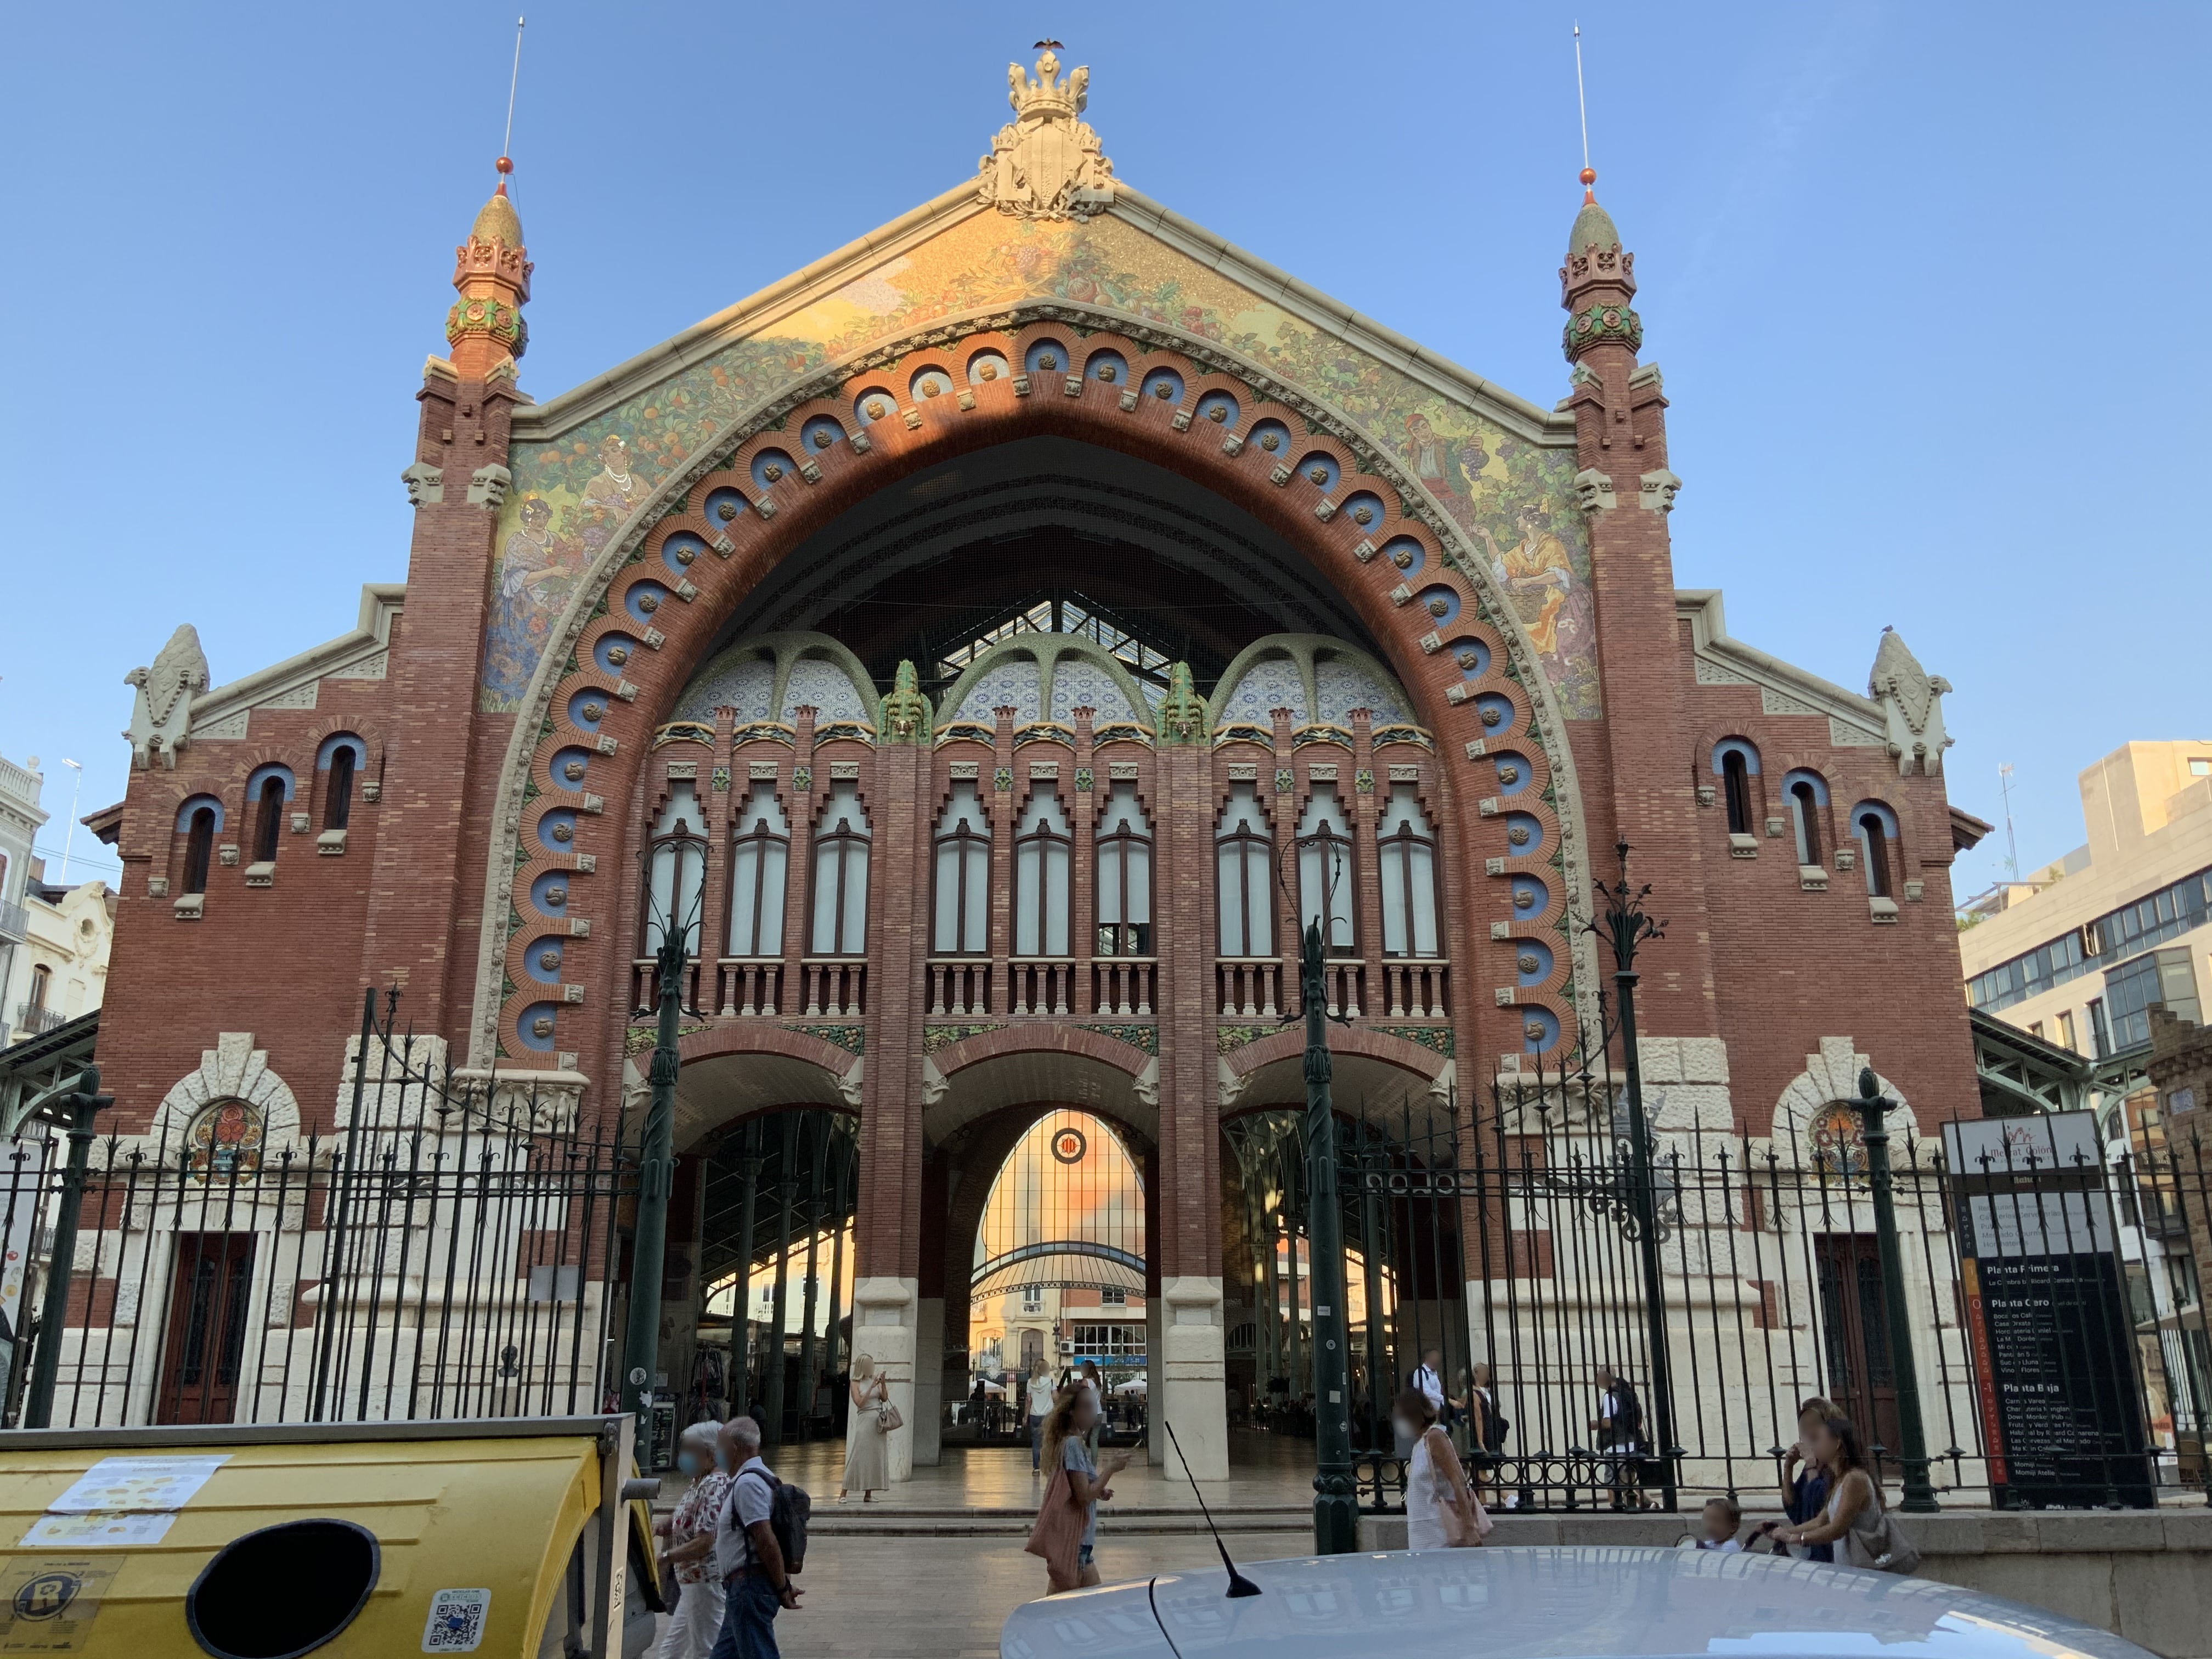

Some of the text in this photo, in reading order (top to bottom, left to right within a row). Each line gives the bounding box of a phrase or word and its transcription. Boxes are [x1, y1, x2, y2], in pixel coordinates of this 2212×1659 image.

[1990, 1148, 2022, 1158] Meat
[1987, 1264, 2059, 1274] Planta Pimea
[1991, 1299, 2023, 1308] Planta
[2025, 1298, 2050, 1307] Cero
